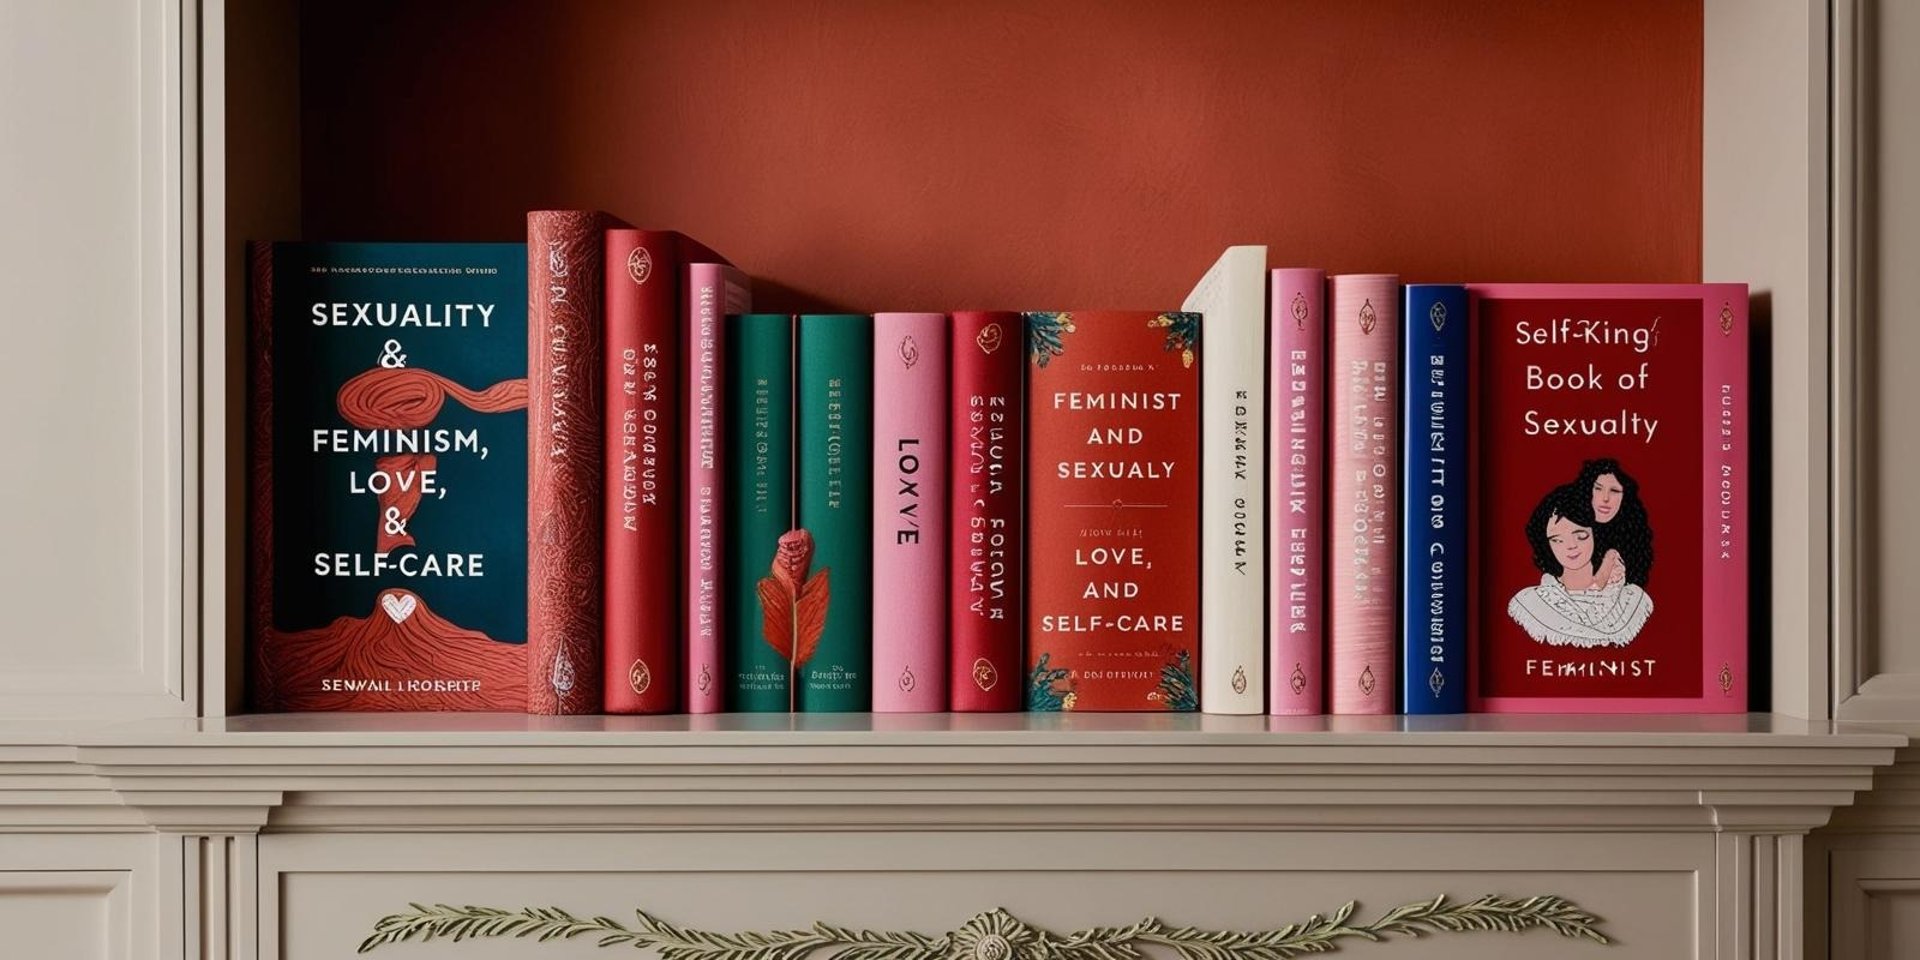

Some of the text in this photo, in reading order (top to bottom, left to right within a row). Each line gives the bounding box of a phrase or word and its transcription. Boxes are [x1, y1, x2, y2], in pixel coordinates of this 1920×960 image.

[311, 302, 496, 328] SEXUALITY
[378, 338, 407, 369] &
[1526, 362, 1649, 390] Book of
[1053, 391, 1181, 411] FEMINIST
[1086, 427, 1144, 445] AND
[1524, 408, 1658, 444] Sexualty
[312, 428, 489, 460] FEMINISM,
[1057, 461, 1176, 479] SEXUALY
[350, 470, 447, 500] LOVE,
[384, 506, 408, 536] &
[314, 552, 484, 577] SELF-CARE
[1075, 547, 1153, 570] LOVE,
[1083, 581, 1139, 599] AND
[1041, 614, 1184, 632] SELF-CARE
